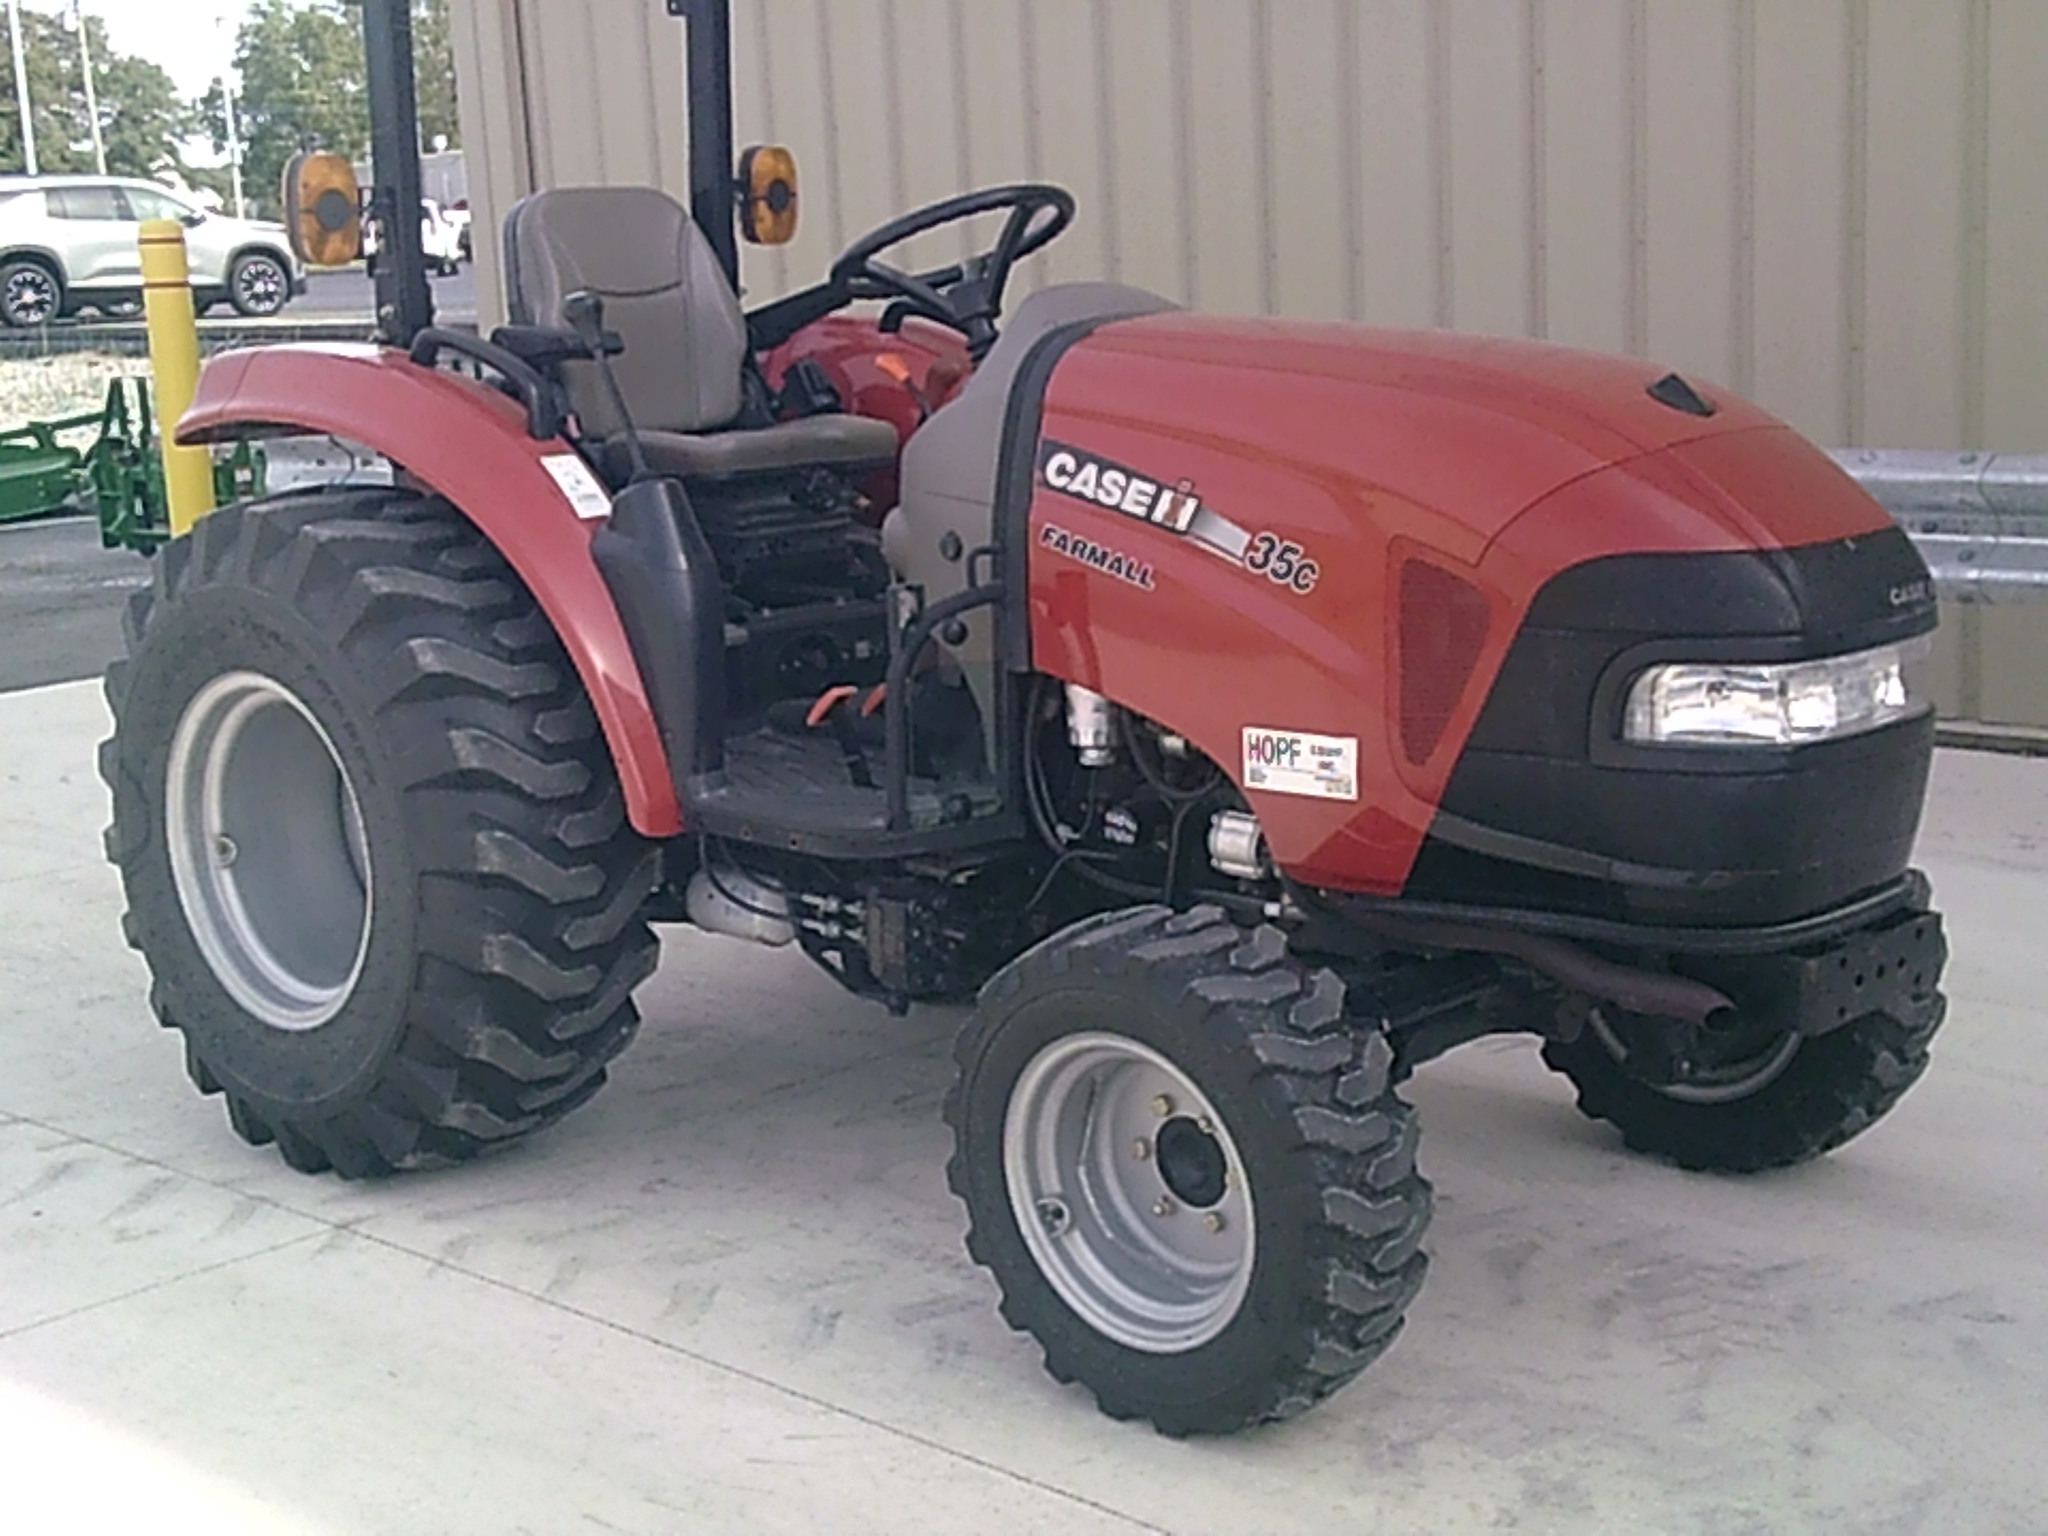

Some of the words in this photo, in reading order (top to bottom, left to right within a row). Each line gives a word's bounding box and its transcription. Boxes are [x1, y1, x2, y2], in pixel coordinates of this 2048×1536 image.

[1045, 452, 1156, 516] CASE
[1248, 532, 1319, 594] 35C
[1041, 525, 1155, 589] FARMALL
[1248, 733, 1301, 766] HOPF
